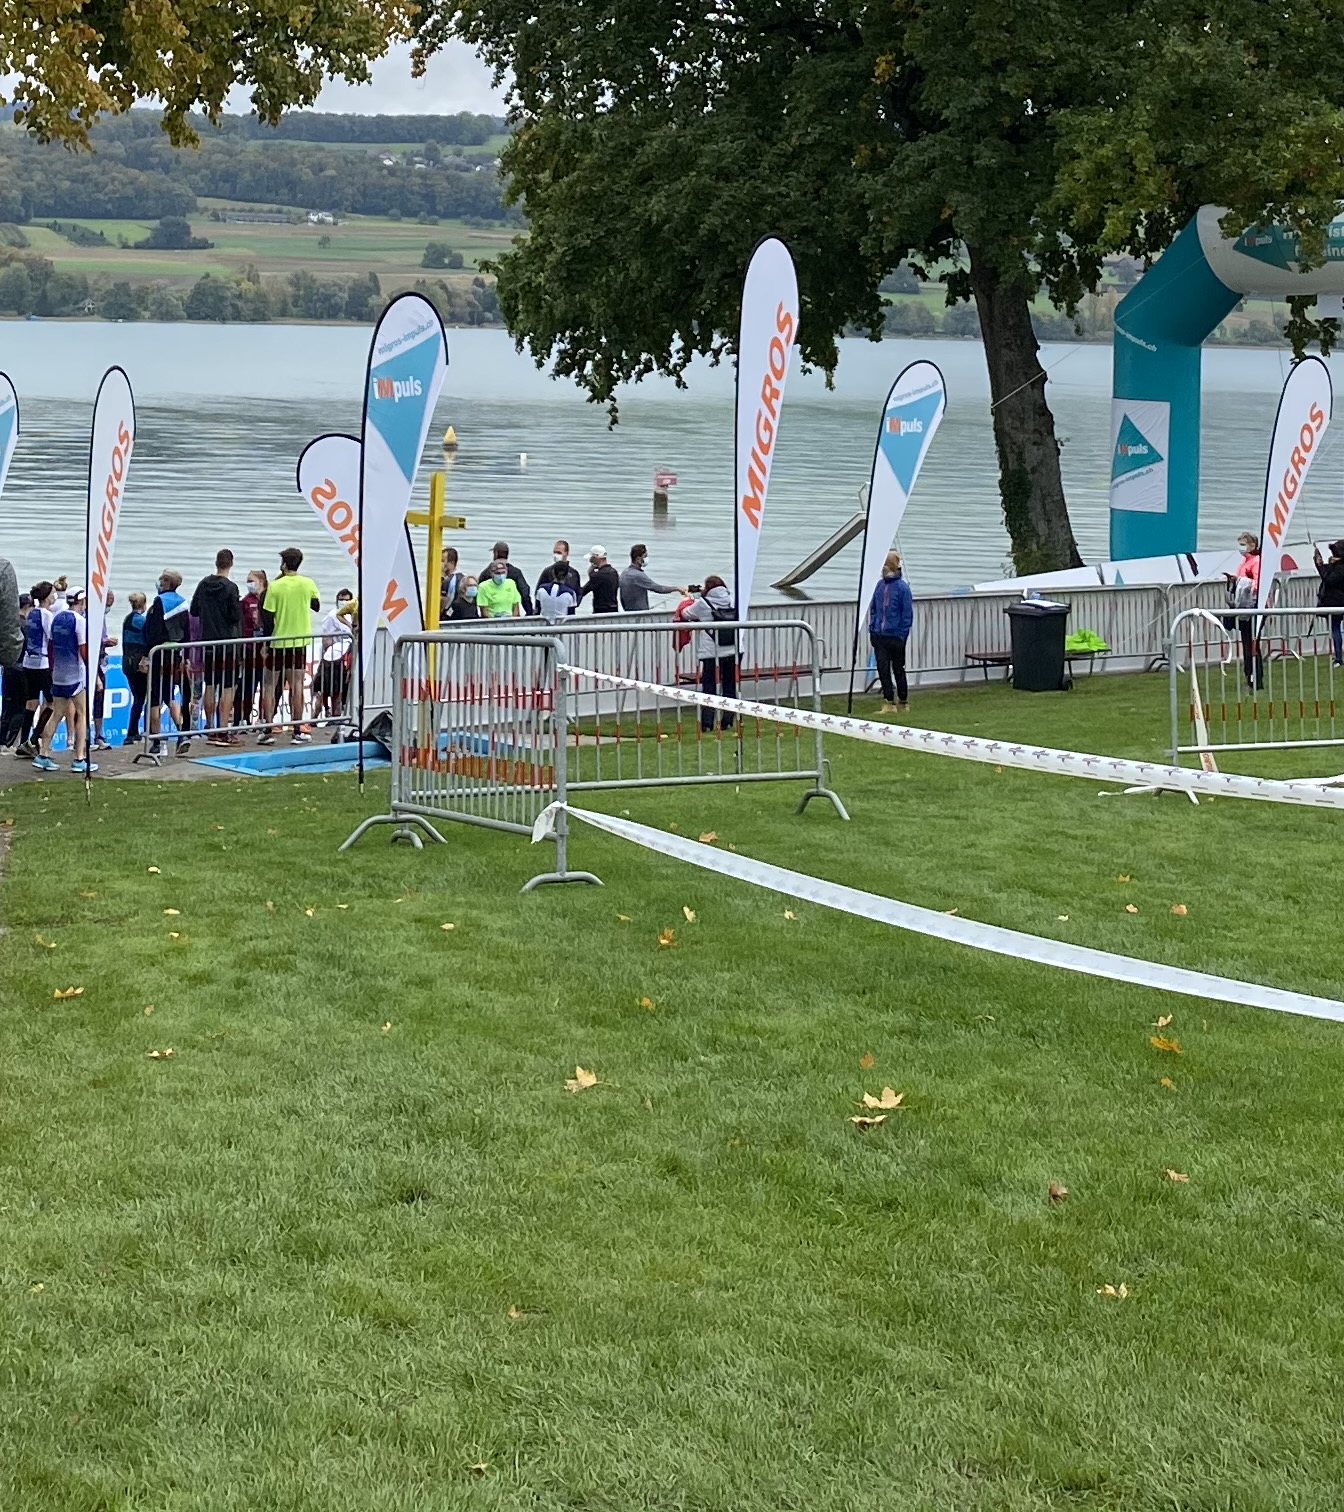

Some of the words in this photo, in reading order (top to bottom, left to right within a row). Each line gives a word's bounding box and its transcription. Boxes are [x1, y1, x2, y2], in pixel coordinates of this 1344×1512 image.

[742, 300, 793, 530] MIGROS
[1268, 401, 1324, 548] MIGROS
[91, 420, 131, 603] MIGROS
